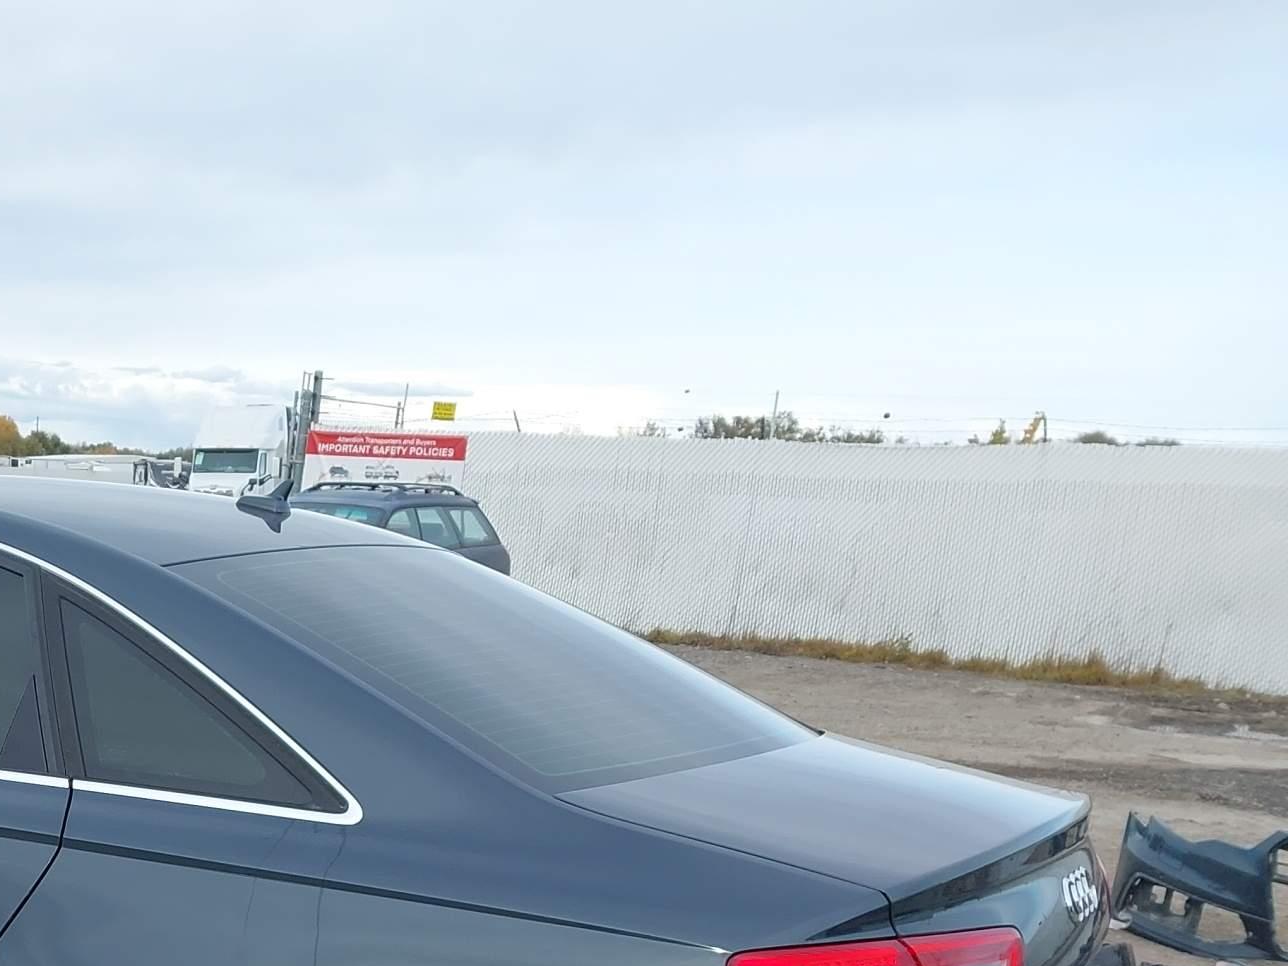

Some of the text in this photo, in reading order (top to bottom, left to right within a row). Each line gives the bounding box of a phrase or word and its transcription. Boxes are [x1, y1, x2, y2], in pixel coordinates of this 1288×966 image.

[318, 443, 454, 457] IMPORTANT SAFETY POLICIES
